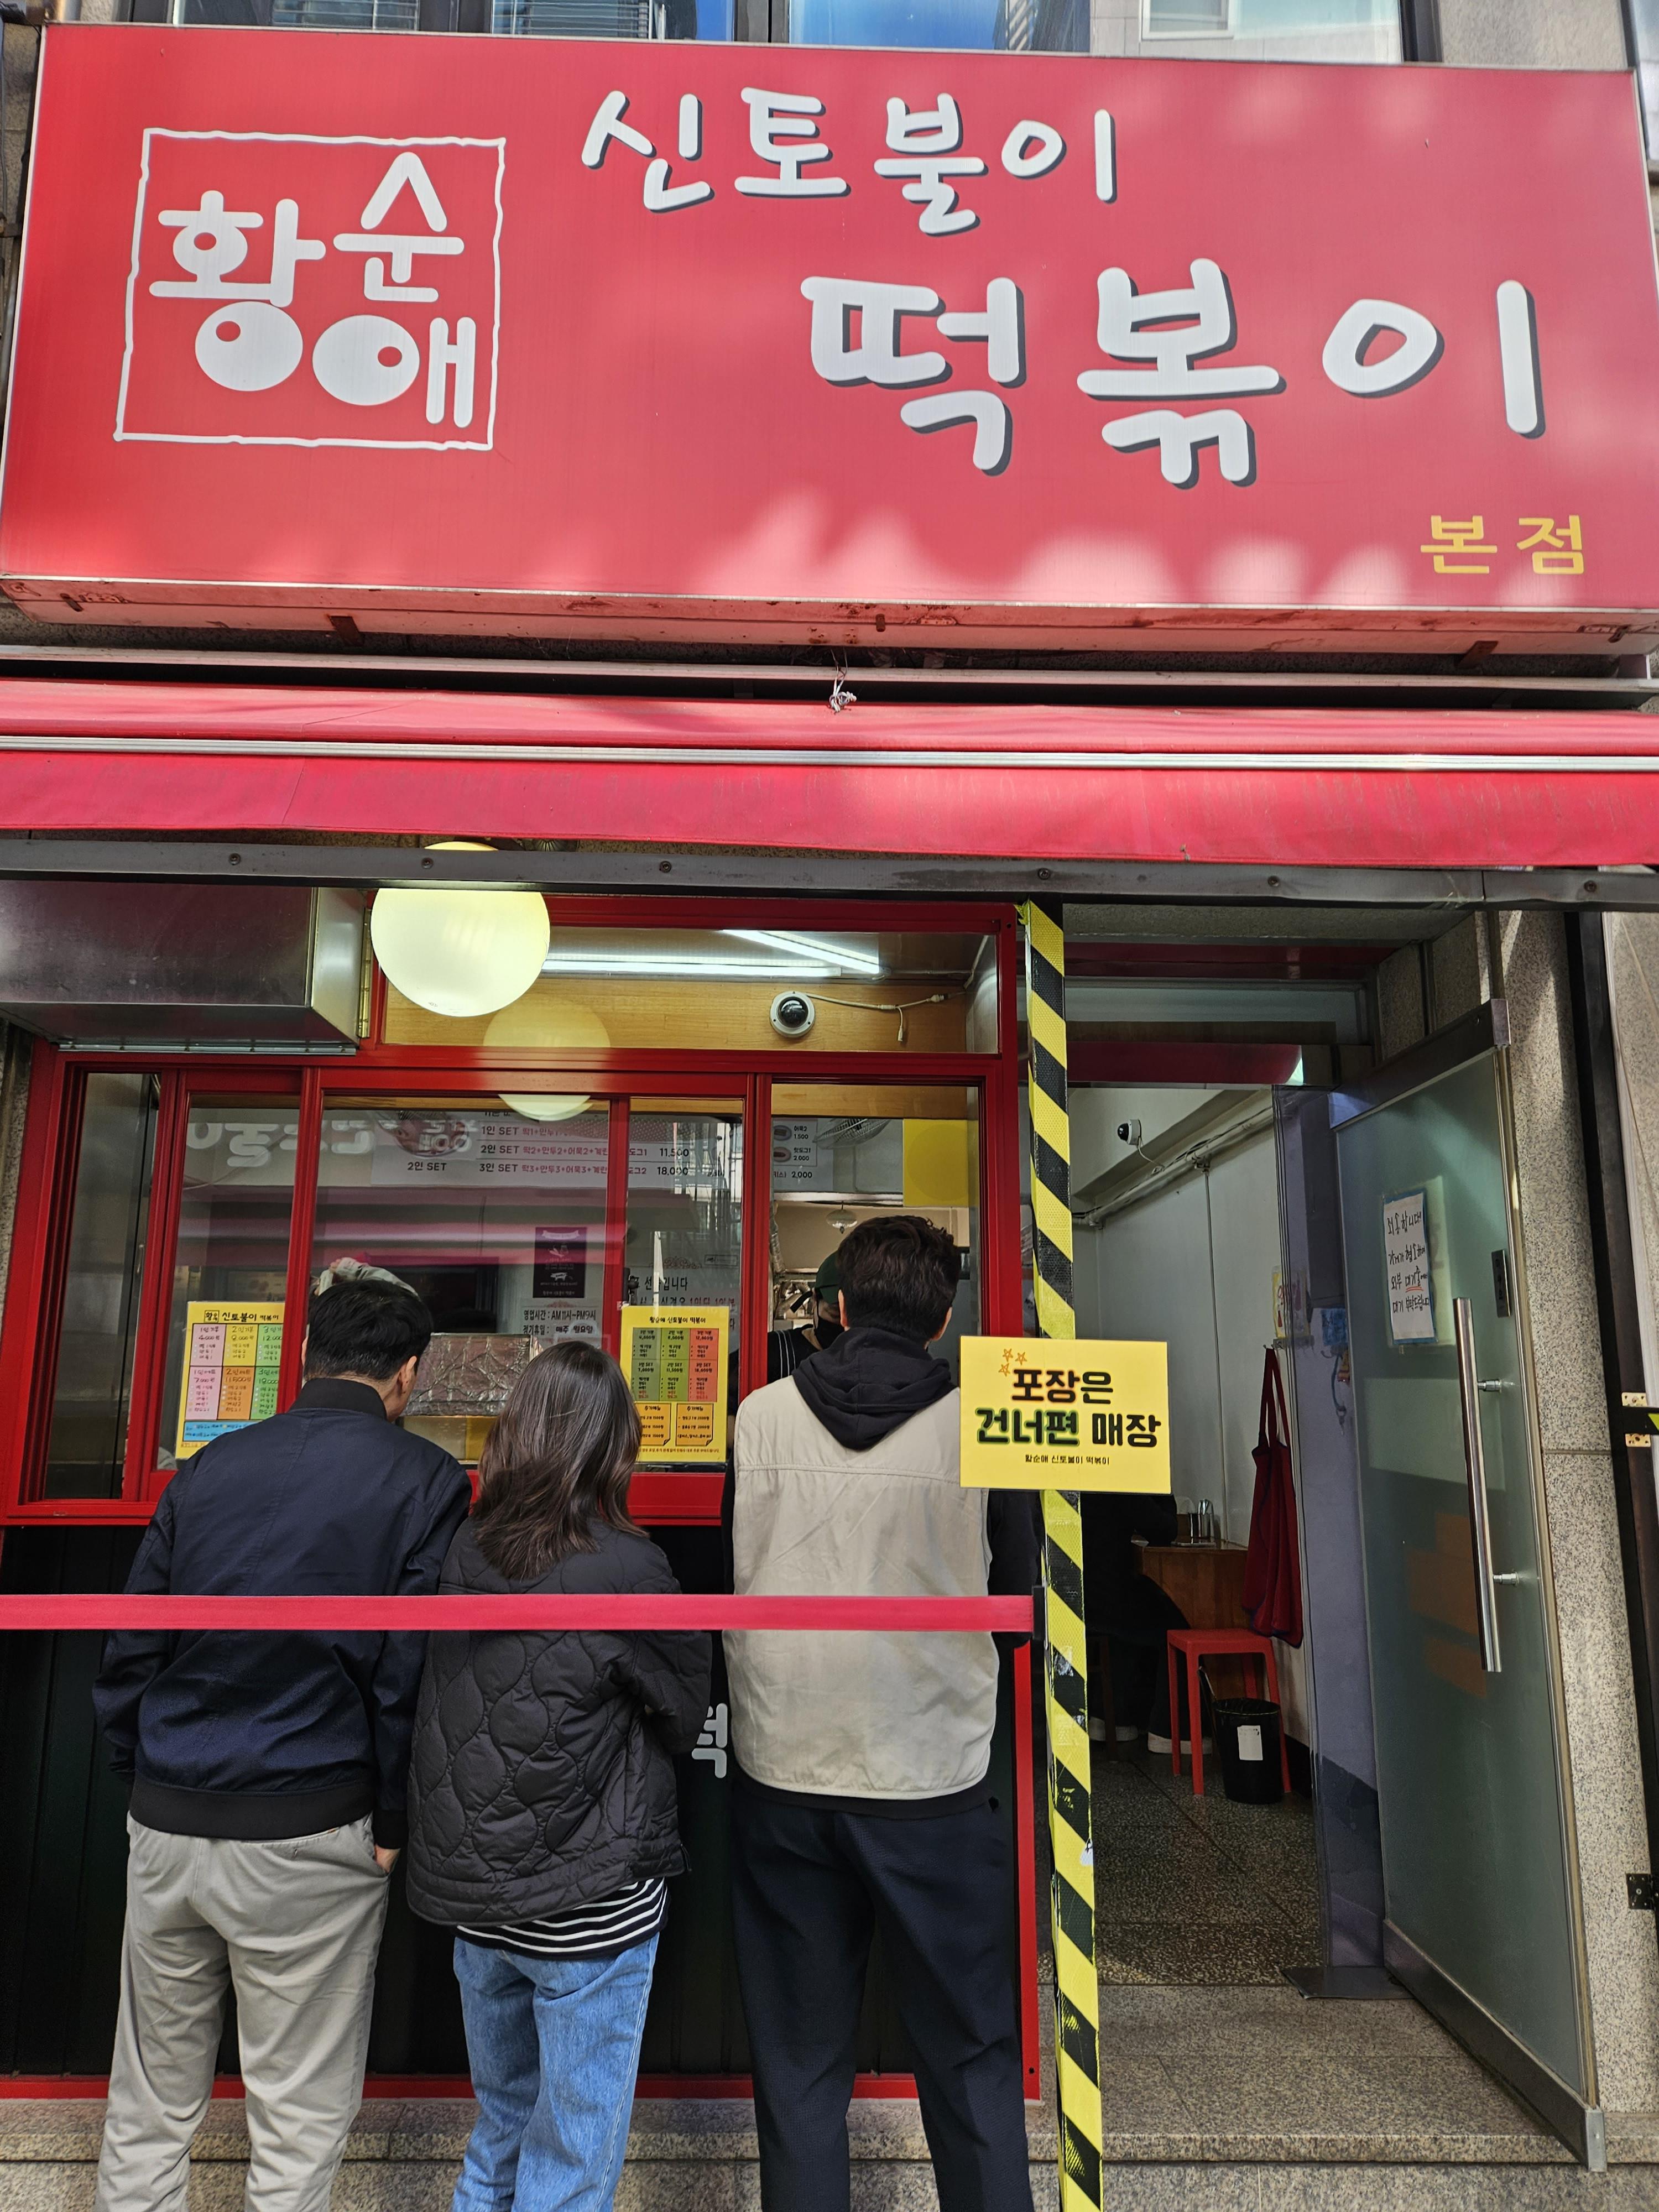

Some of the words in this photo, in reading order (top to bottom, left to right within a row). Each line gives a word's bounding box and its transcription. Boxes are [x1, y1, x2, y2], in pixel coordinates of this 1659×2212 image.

[581, 87, 1115, 234] 신토불이
[149, 152, 476, 428] 황순애
[801, 258, 1543, 488] 떡볶이
[482, 1126, 495, 1135] 1인
[499, 1126, 519, 1135] SET
[481, 1145, 495, 1154] 2인
[408, 1161, 423, 1171] 2인
[427, 1162, 447, 1171] SET
[479, 1164, 494, 1172] 3인
[498, 1164, 518, 1172] SET
[645, 1276, 687, 1291] 선입니다
[1393, 1301, 1404, 1313] 대기
[222, 1312, 257, 1322] 신토불이
[524, 1310, 546, 1321] 영업시간
[523, 1325, 545, 1335] 정기휴일
[1011, 1369, 1113, 1404] 포장은
[976, 1409, 1079, 1446] 건너편
[1092, 1413, 1161, 1447] 매장
[1052, 1455, 1083, 1464] 신토불이
[1086, 1456, 1109, 1465] 떡볶이
